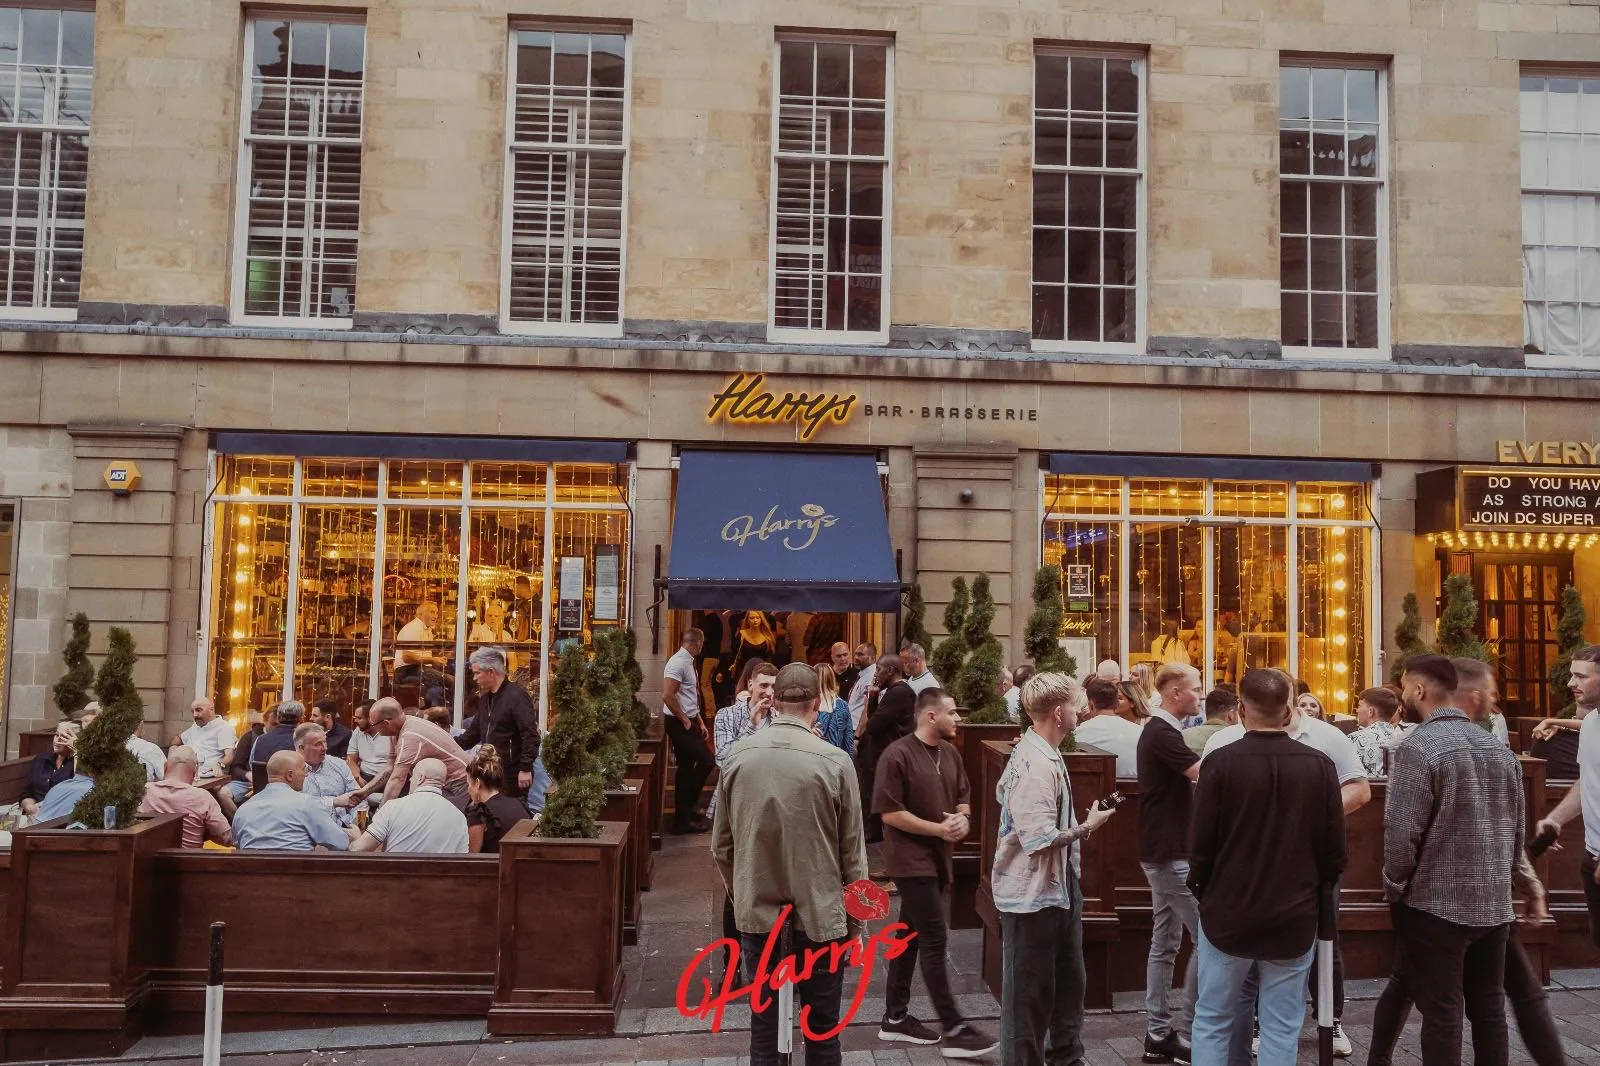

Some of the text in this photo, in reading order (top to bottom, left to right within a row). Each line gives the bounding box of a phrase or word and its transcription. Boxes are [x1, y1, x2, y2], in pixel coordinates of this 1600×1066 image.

[708, 374, 1037, 439] Harrys BAR BRASSERIE
[1496, 440, 1600, 465] EVERY
[111, 471, 126, 480] ADT
[1488, 477, 1511, 489] DO
[1529, 478, 1561, 490] YOU
[1483, 494, 1504, 506] AS
[1522, 495, 1586, 508] STRONG
[1472, 511, 1594, 525] JOIN DC SUPER
[720, 504, 840, 551] Harrys
